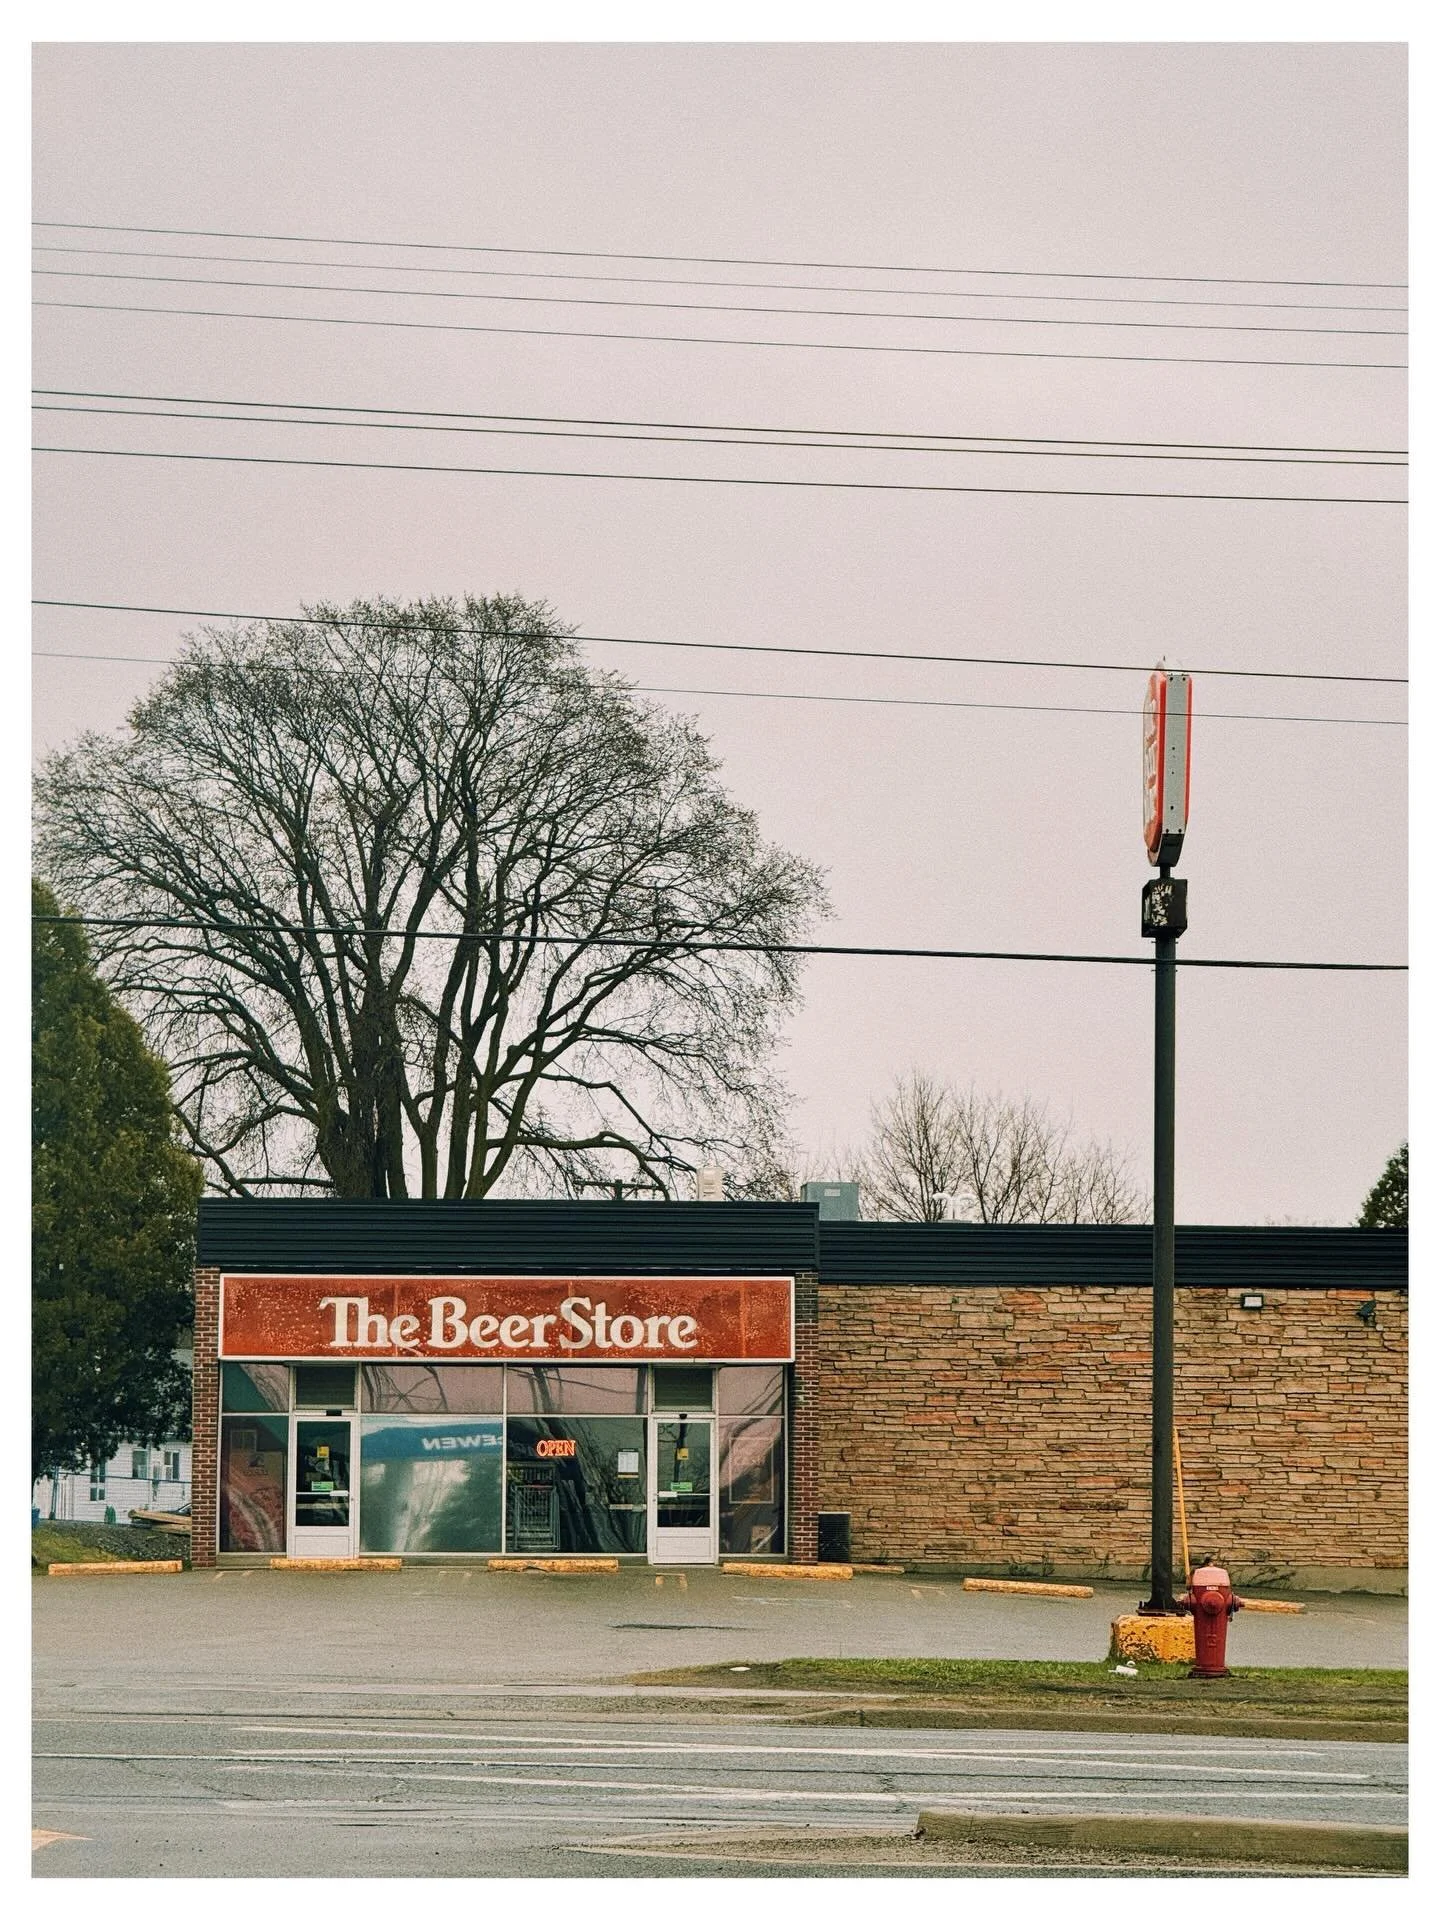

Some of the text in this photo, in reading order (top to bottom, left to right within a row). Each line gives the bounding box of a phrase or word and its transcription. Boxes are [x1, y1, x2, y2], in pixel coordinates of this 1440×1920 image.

[319, 1296, 698, 1350] The Beer Store
[536, 1440, 576, 1457] OPEN
